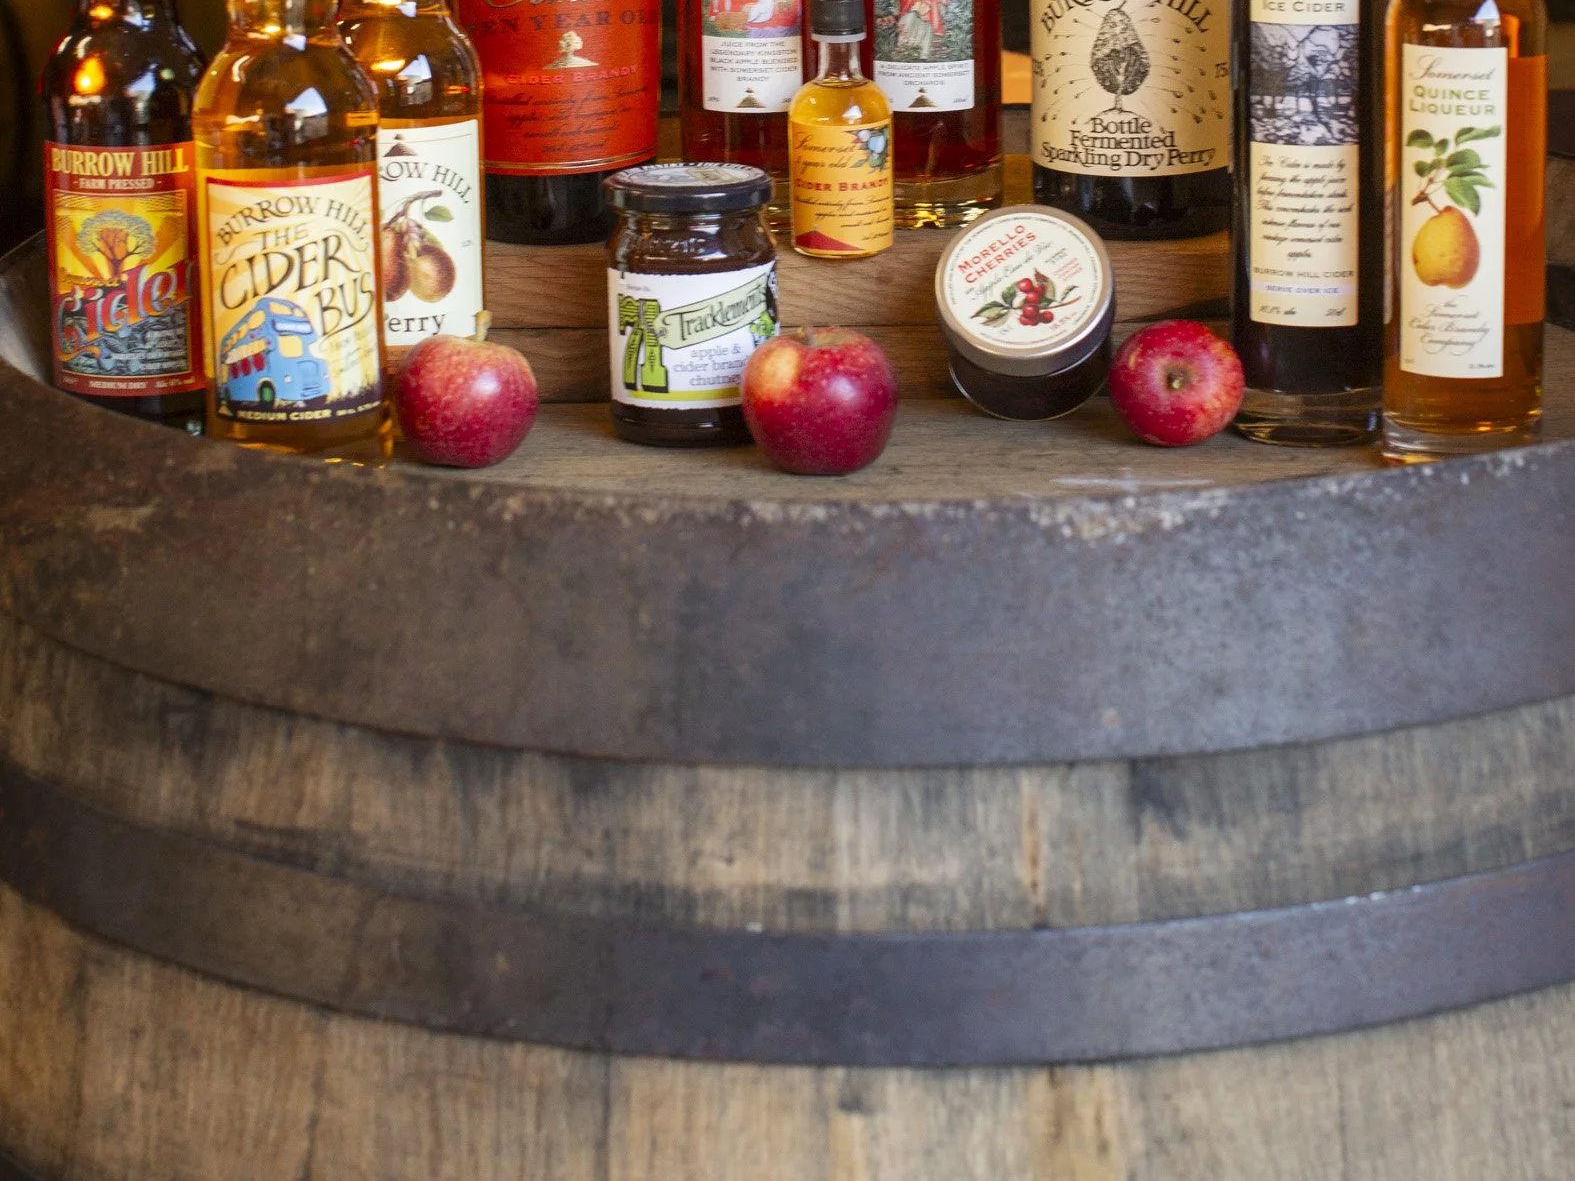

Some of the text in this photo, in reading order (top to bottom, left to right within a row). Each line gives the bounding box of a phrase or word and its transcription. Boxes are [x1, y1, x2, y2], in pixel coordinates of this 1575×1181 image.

[1262, 0, 1346, 13] ICE CIDER
[1409, 53, 1496, 82] Somerset
[1413, 85, 1490, 101] QUINCE
[1408, 99, 1497, 117] LIQUEUR
[1068, 129, 1177, 150] Fermented
[1090, 116, 1153, 135] Bottle
[51, 147, 190, 176] BURROW HILL
[1040, 141, 1217, 171] Sparkling Dry Perry
[107, 178, 155, 190] PRESSED
[432, 164, 473, 204] HILL
[216, 195, 371, 246] BURROW HILL
[254, 222, 310, 250] THE
[958, 224, 1026, 274] MORELLO
[219, 234, 361, 310] CIDER
[964, 231, 1038, 285] CHERRIES
[54, 259, 194, 363] Cider
[314, 270, 376, 339] BUS
[384, 314, 446, 336] erry
[690, 343, 744, 361] apple &
[673, 360, 708, 373] cider
[289, 409, 332, 422] CIDER
